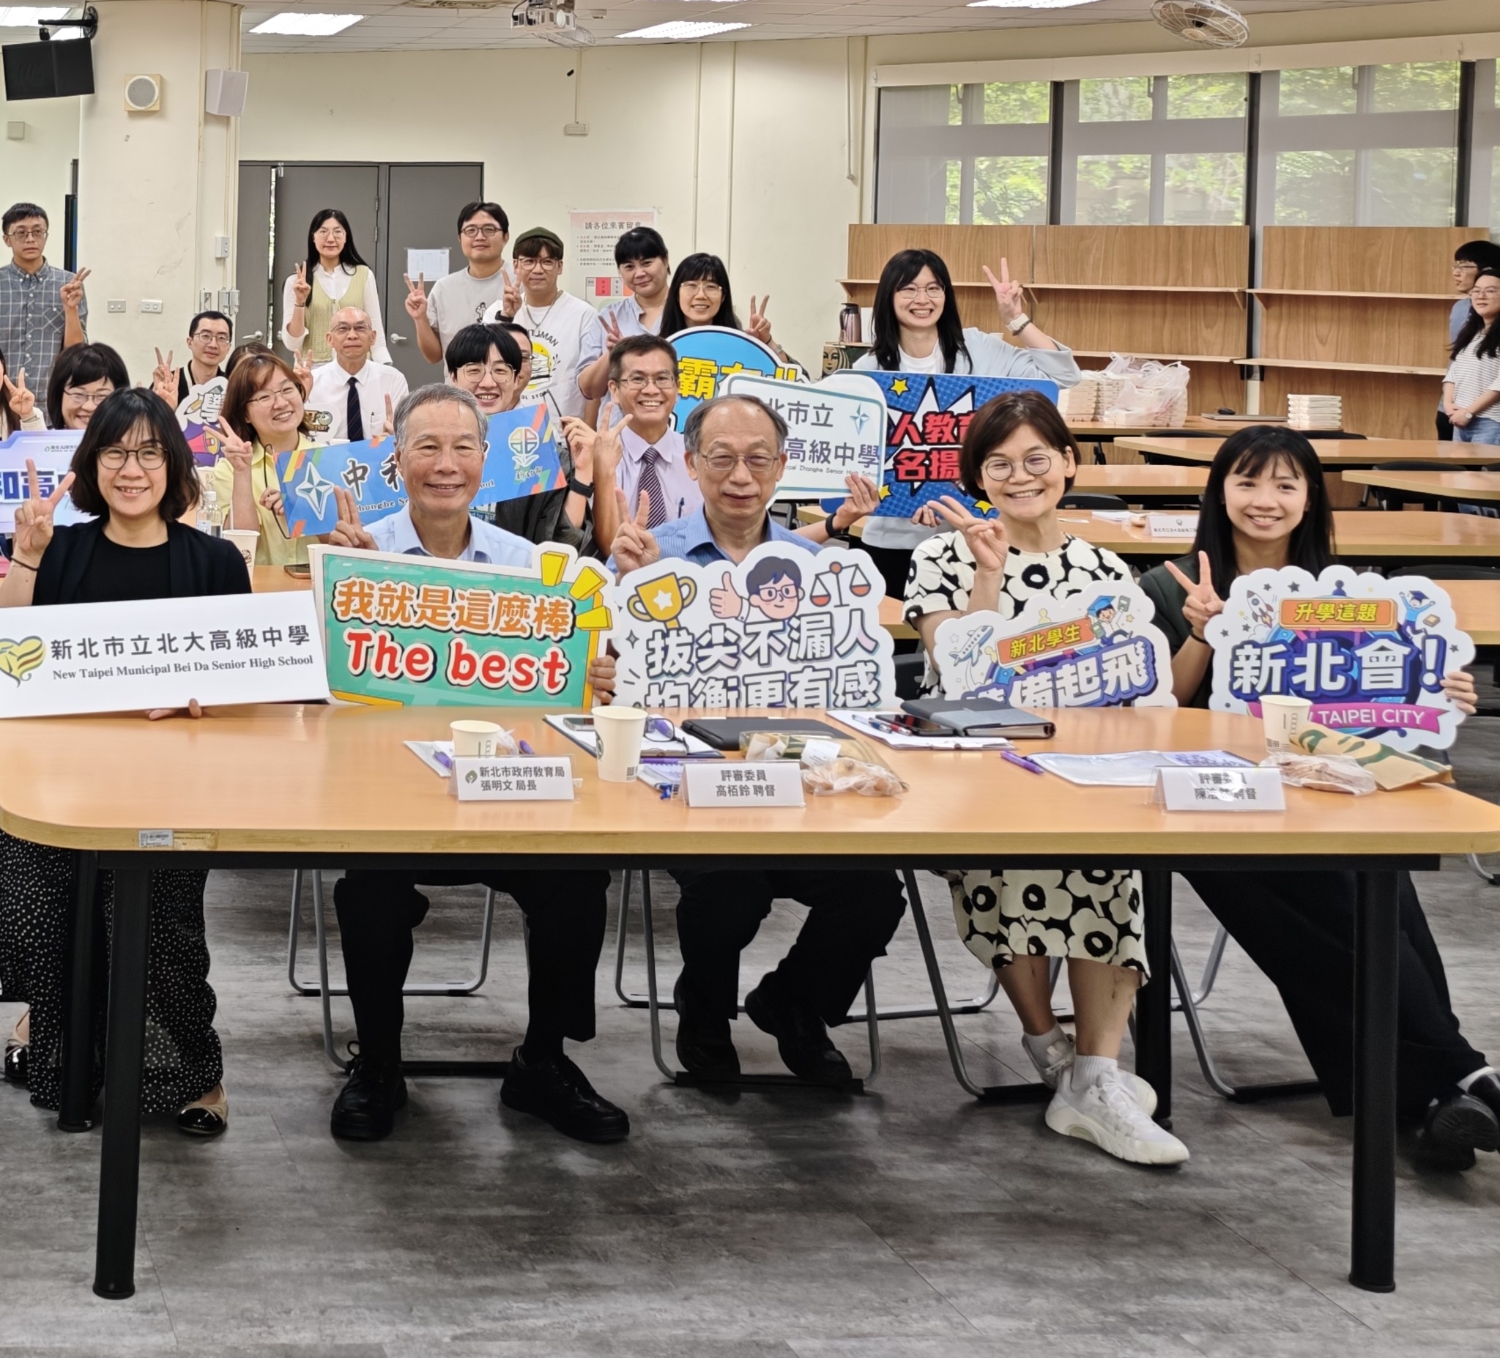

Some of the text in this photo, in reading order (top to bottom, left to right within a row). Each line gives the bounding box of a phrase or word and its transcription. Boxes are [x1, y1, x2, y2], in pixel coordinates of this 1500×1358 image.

[785, 437, 880, 468] 高級中學
[356, 498, 396, 512] honghe
[336, 580, 572, 637] 我就是這麼棒
[1294, 603, 1378, 622] 升學這題
[50, 624, 310, 660] 新北市立北大高級中學
[647, 608, 879, 677] 拔尖不漏人
[1010, 623, 1081, 658] 新北學生
[53, 654, 314, 680] New Taipei Municipal Bei Da Senior High School
[348, 631, 567, 690] The best
[977, 641, 1149, 707] 備起飛
[646, 660, 879, 707] 均衡更有感
[1321, 709, 1425, 725] TAIPEI CITY
[479, 766, 565, 778] 新北市政府教育局
[481, 780, 537, 791] 張明文 局長
[721, 769, 767, 781] 評審委員
[753, 784, 776, 797] 聘督
